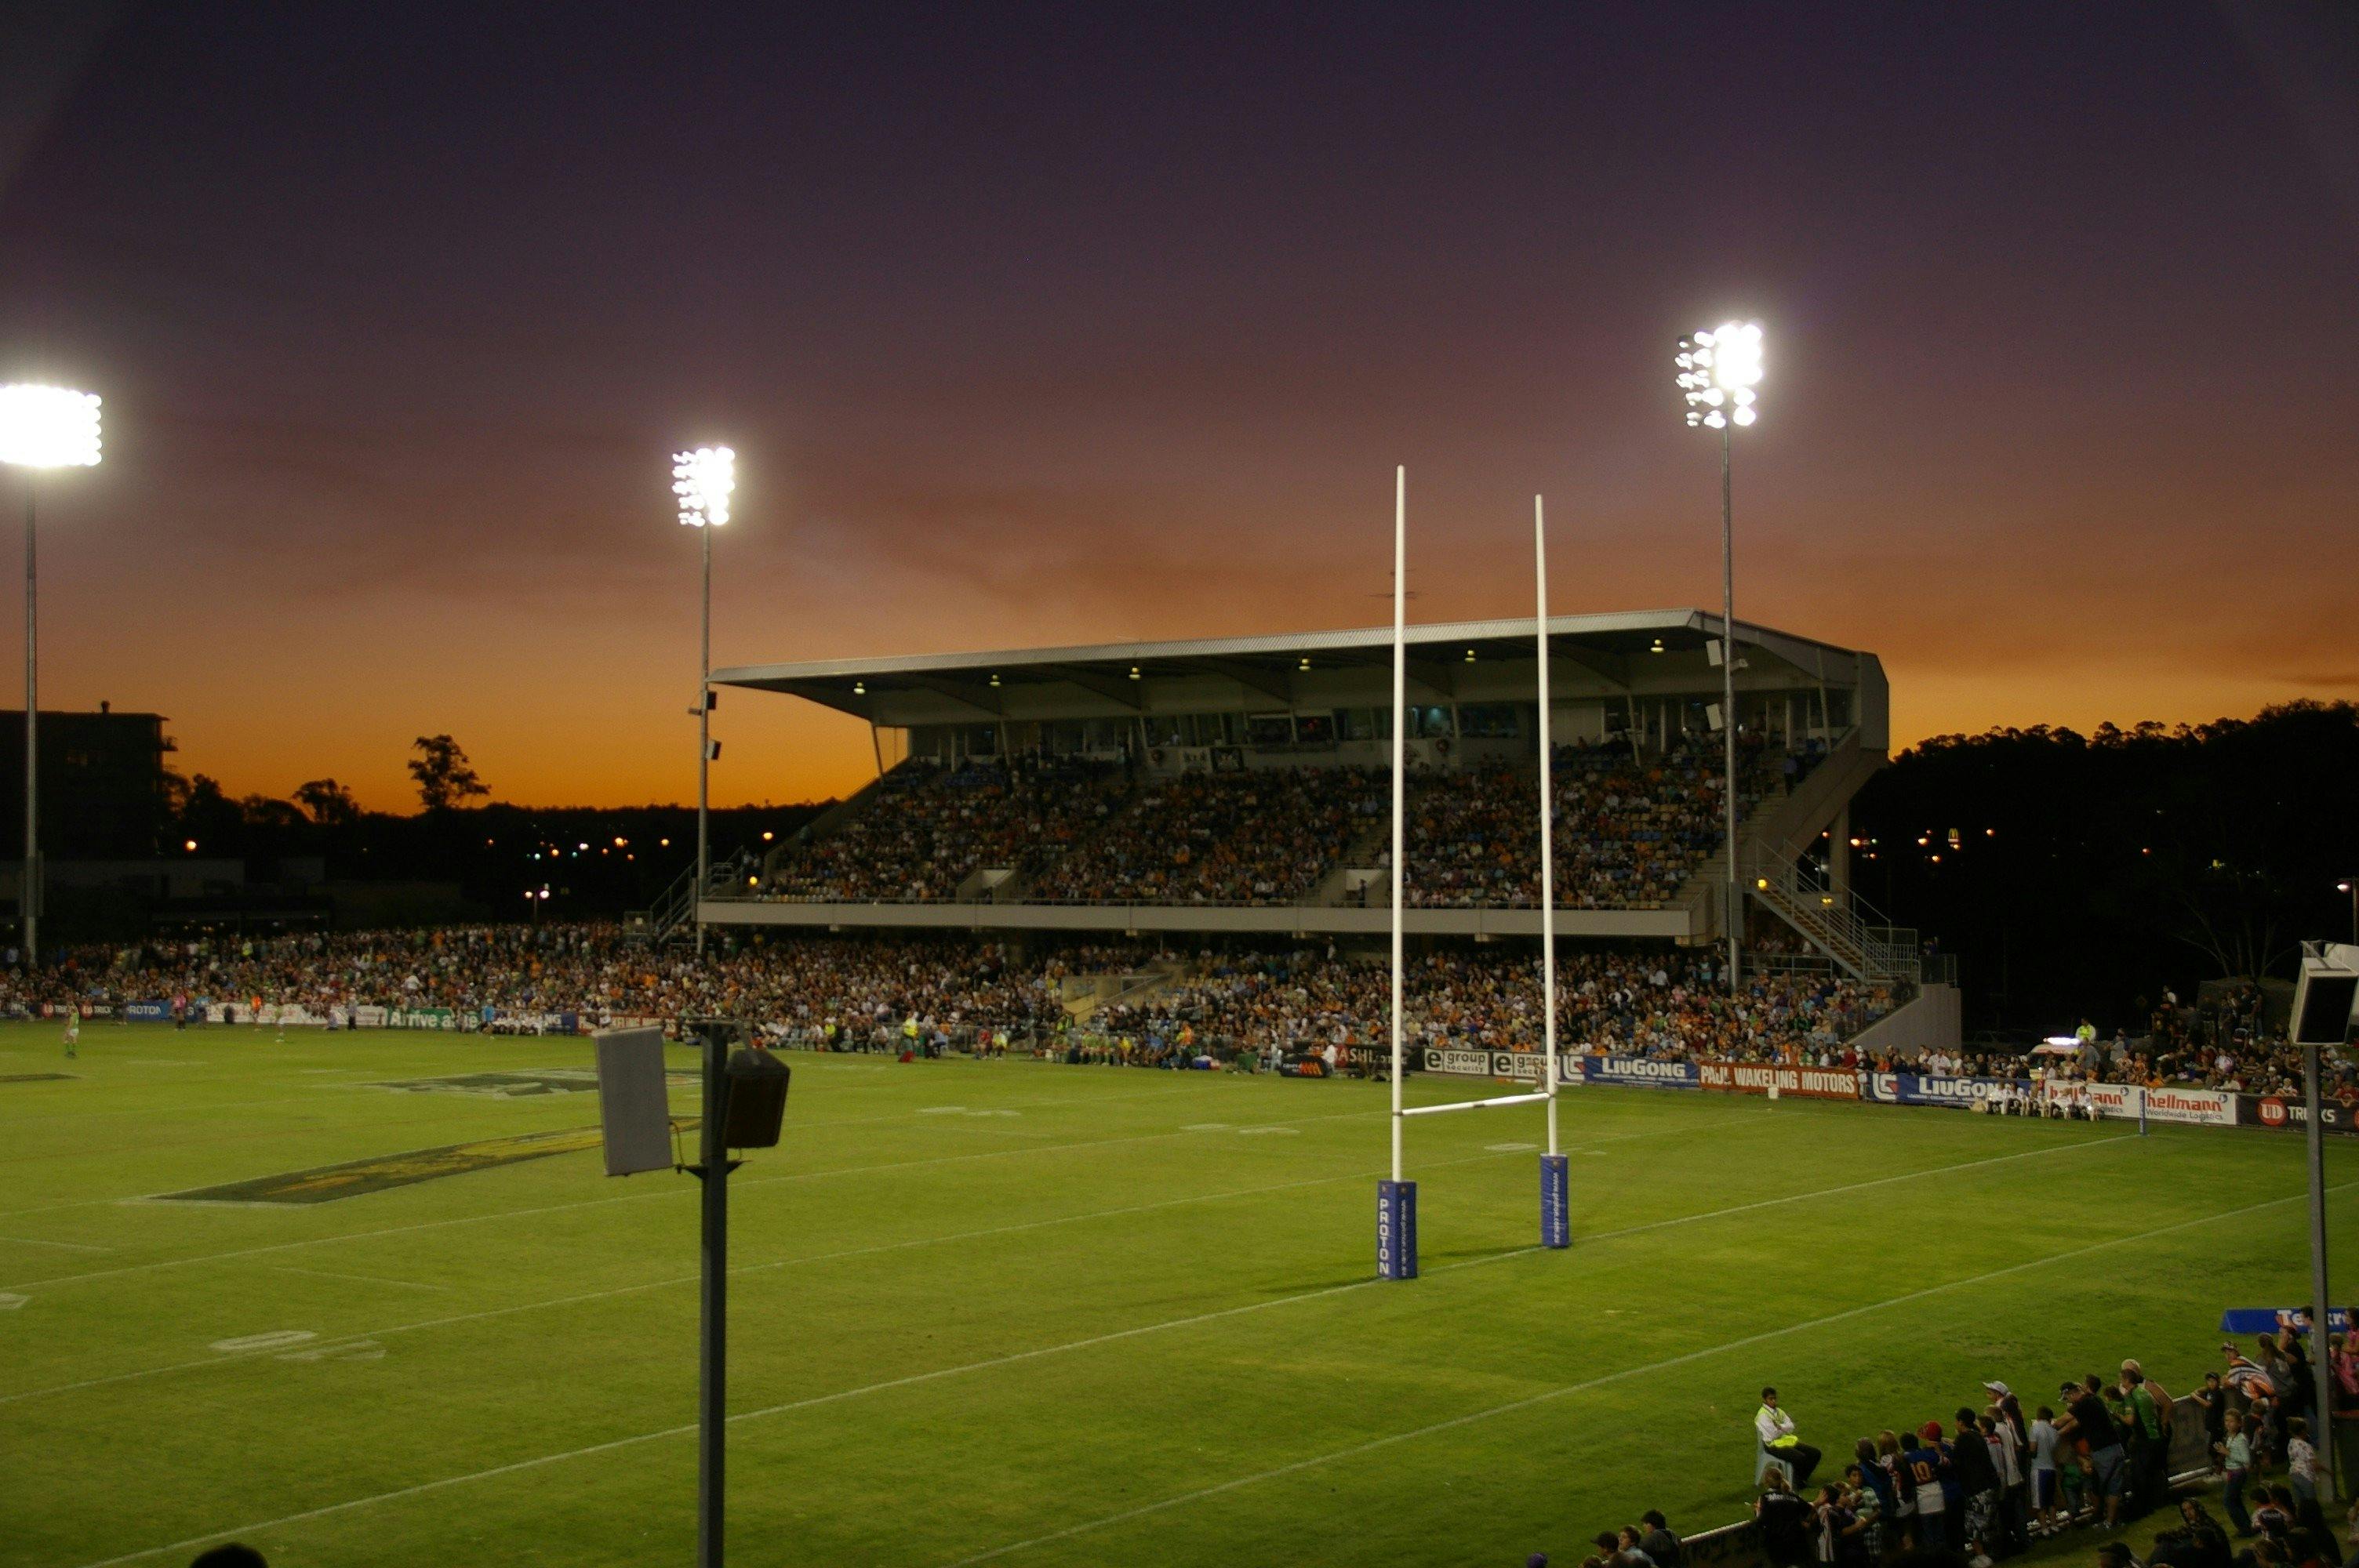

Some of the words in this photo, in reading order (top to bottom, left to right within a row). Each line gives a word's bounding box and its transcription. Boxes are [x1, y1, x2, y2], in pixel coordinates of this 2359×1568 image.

[1427, 1051, 1441, 1068] e
[1447, 1052, 1486, 1064] group
[1496, 1054, 1511, 1073] e
[1734, 1066, 1798, 1090] WAKELING
[1801, 1070, 1856, 1094] MOTORS
[2146, 1093, 2222, 1112] hellmann
[2146, 1109, 2187, 1119] Worldwide
[2260, 1102, 2283, 1120] UD
[2288, 1105, 2335, 1123] TRKS
[1379, 1198, 1390, 1275] PROTON
[1910, 1461, 1932, 1481] 10
